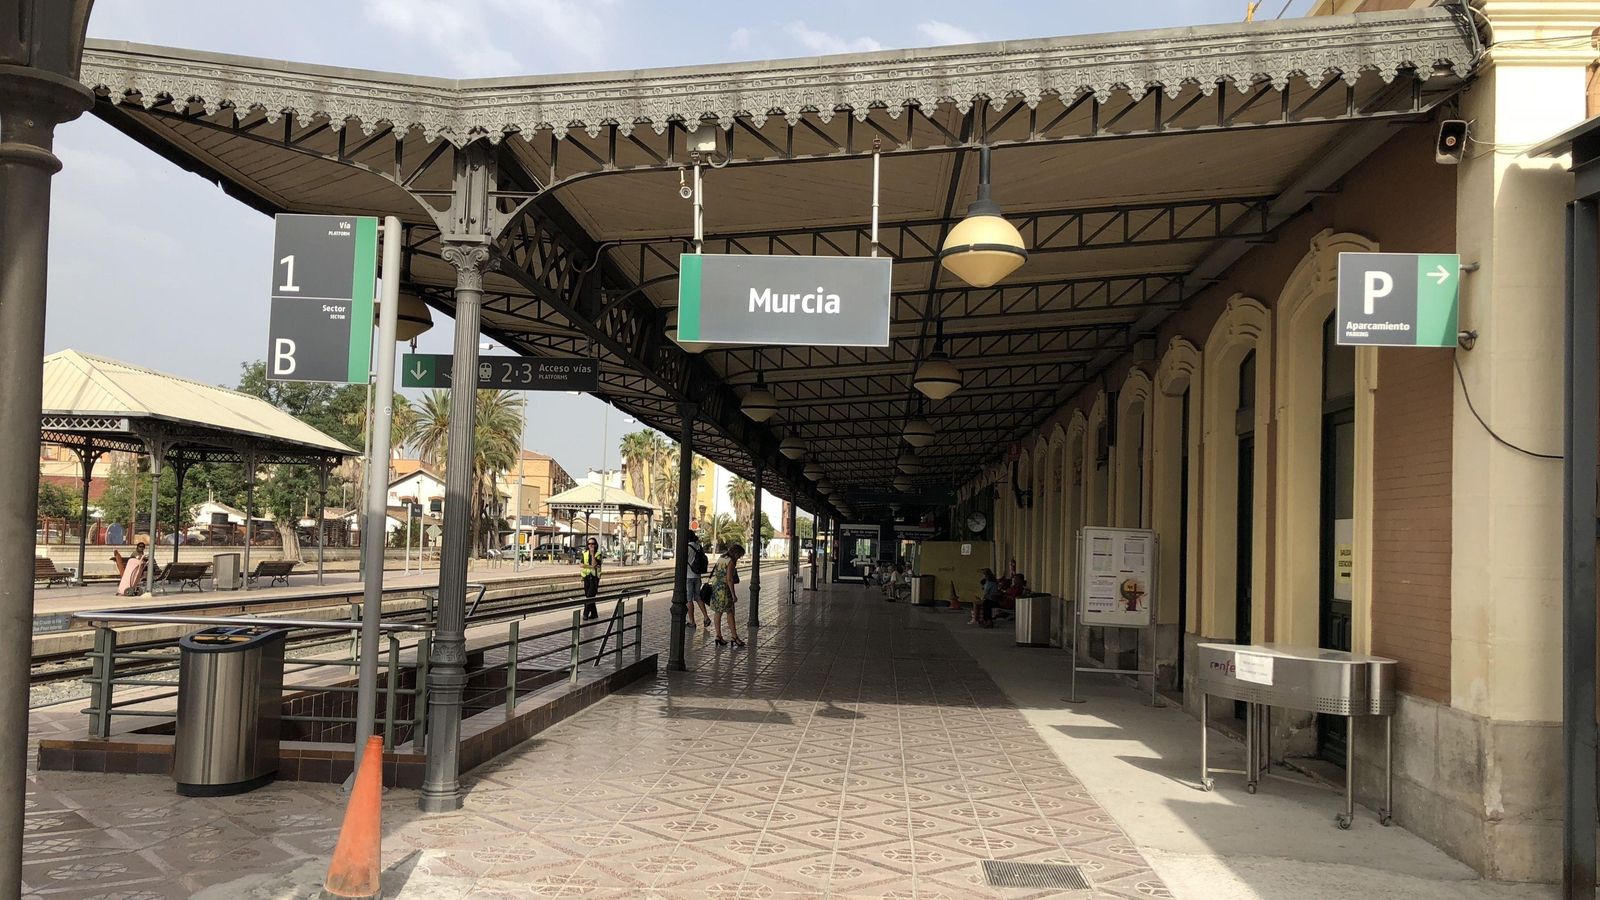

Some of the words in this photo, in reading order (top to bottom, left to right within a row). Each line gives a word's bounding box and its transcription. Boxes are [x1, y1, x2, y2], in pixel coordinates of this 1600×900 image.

[339, 221, 351, 229] Vía
[279, 254, 300, 292] 1
[748, 286, 841, 314] Murcia
[1364, 270, 1394, 315] P
[322, 304, 346, 312] Sector
[1346, 321, 1411, 331] Aparcamiento
[274, 337, 297, 375] B
[538, 363, 570, 373] Acceso
[573, 363, 592, 373] vías
